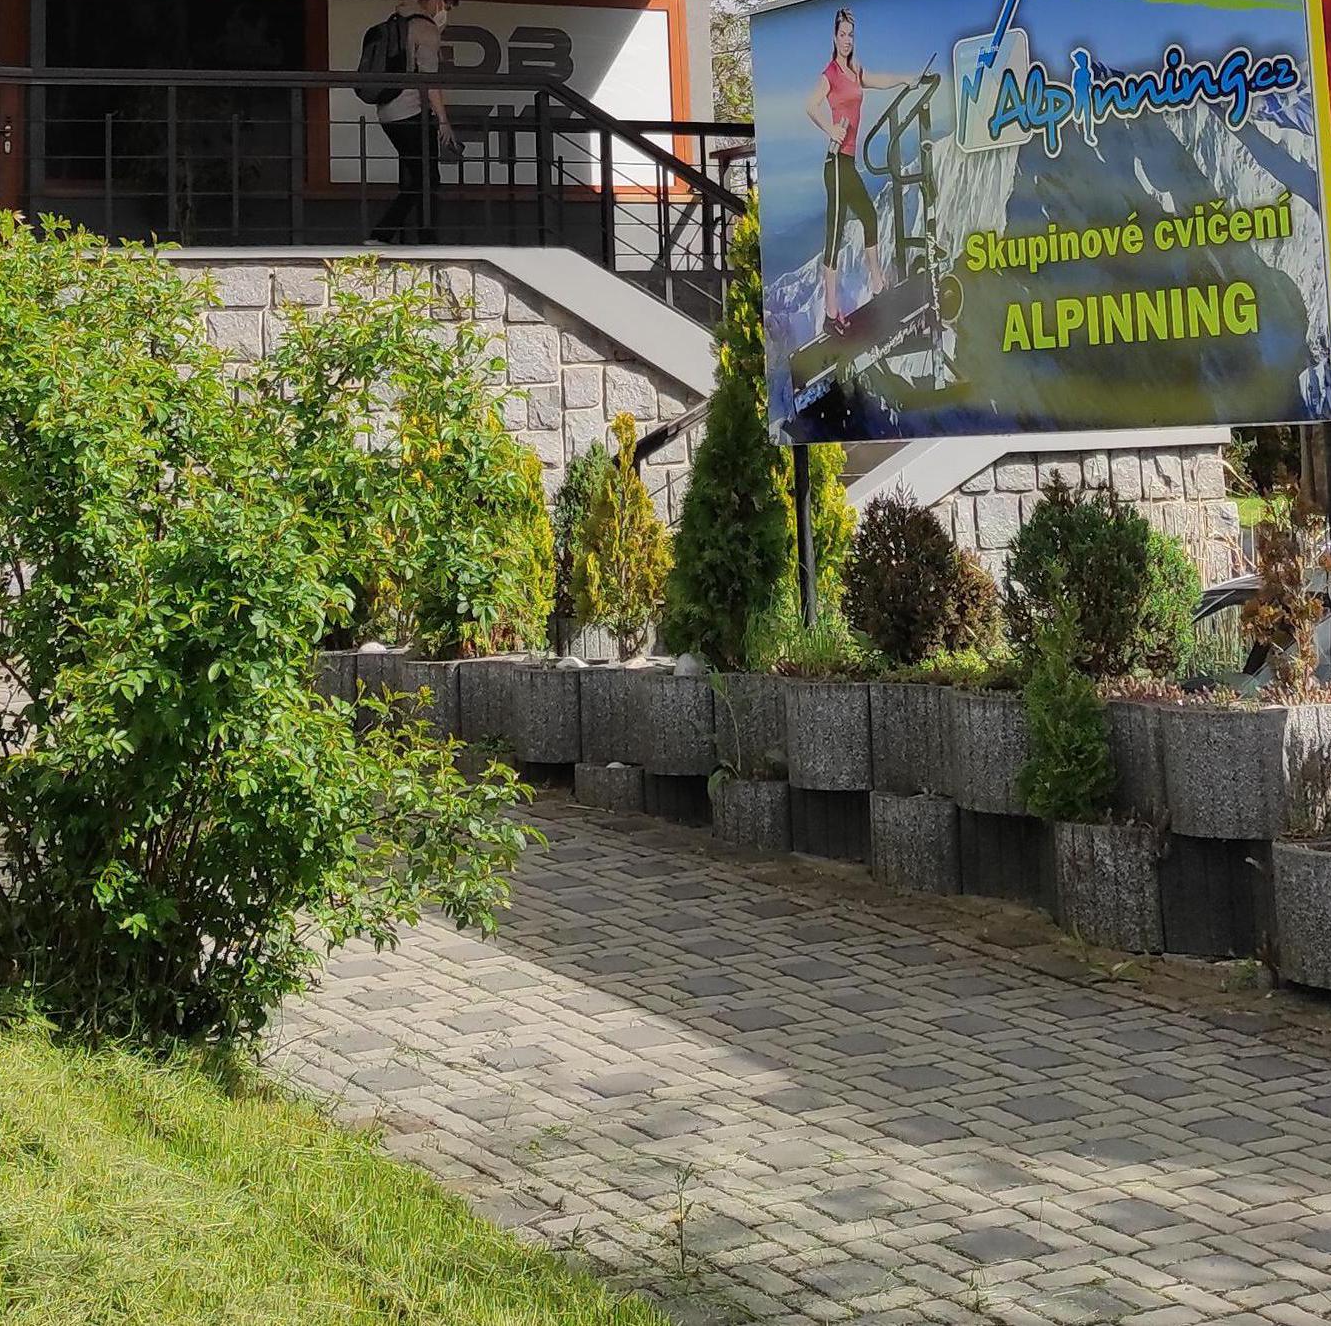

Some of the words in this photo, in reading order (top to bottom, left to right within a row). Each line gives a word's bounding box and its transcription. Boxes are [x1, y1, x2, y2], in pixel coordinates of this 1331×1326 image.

[988, 45, 1299, 155] Alpinning.cz
[966, 212, 1145, 273] Skupinové
[1154, 192, 1293, 250] cvičení
[1002, 281, 1258, 352] ALPINNING
